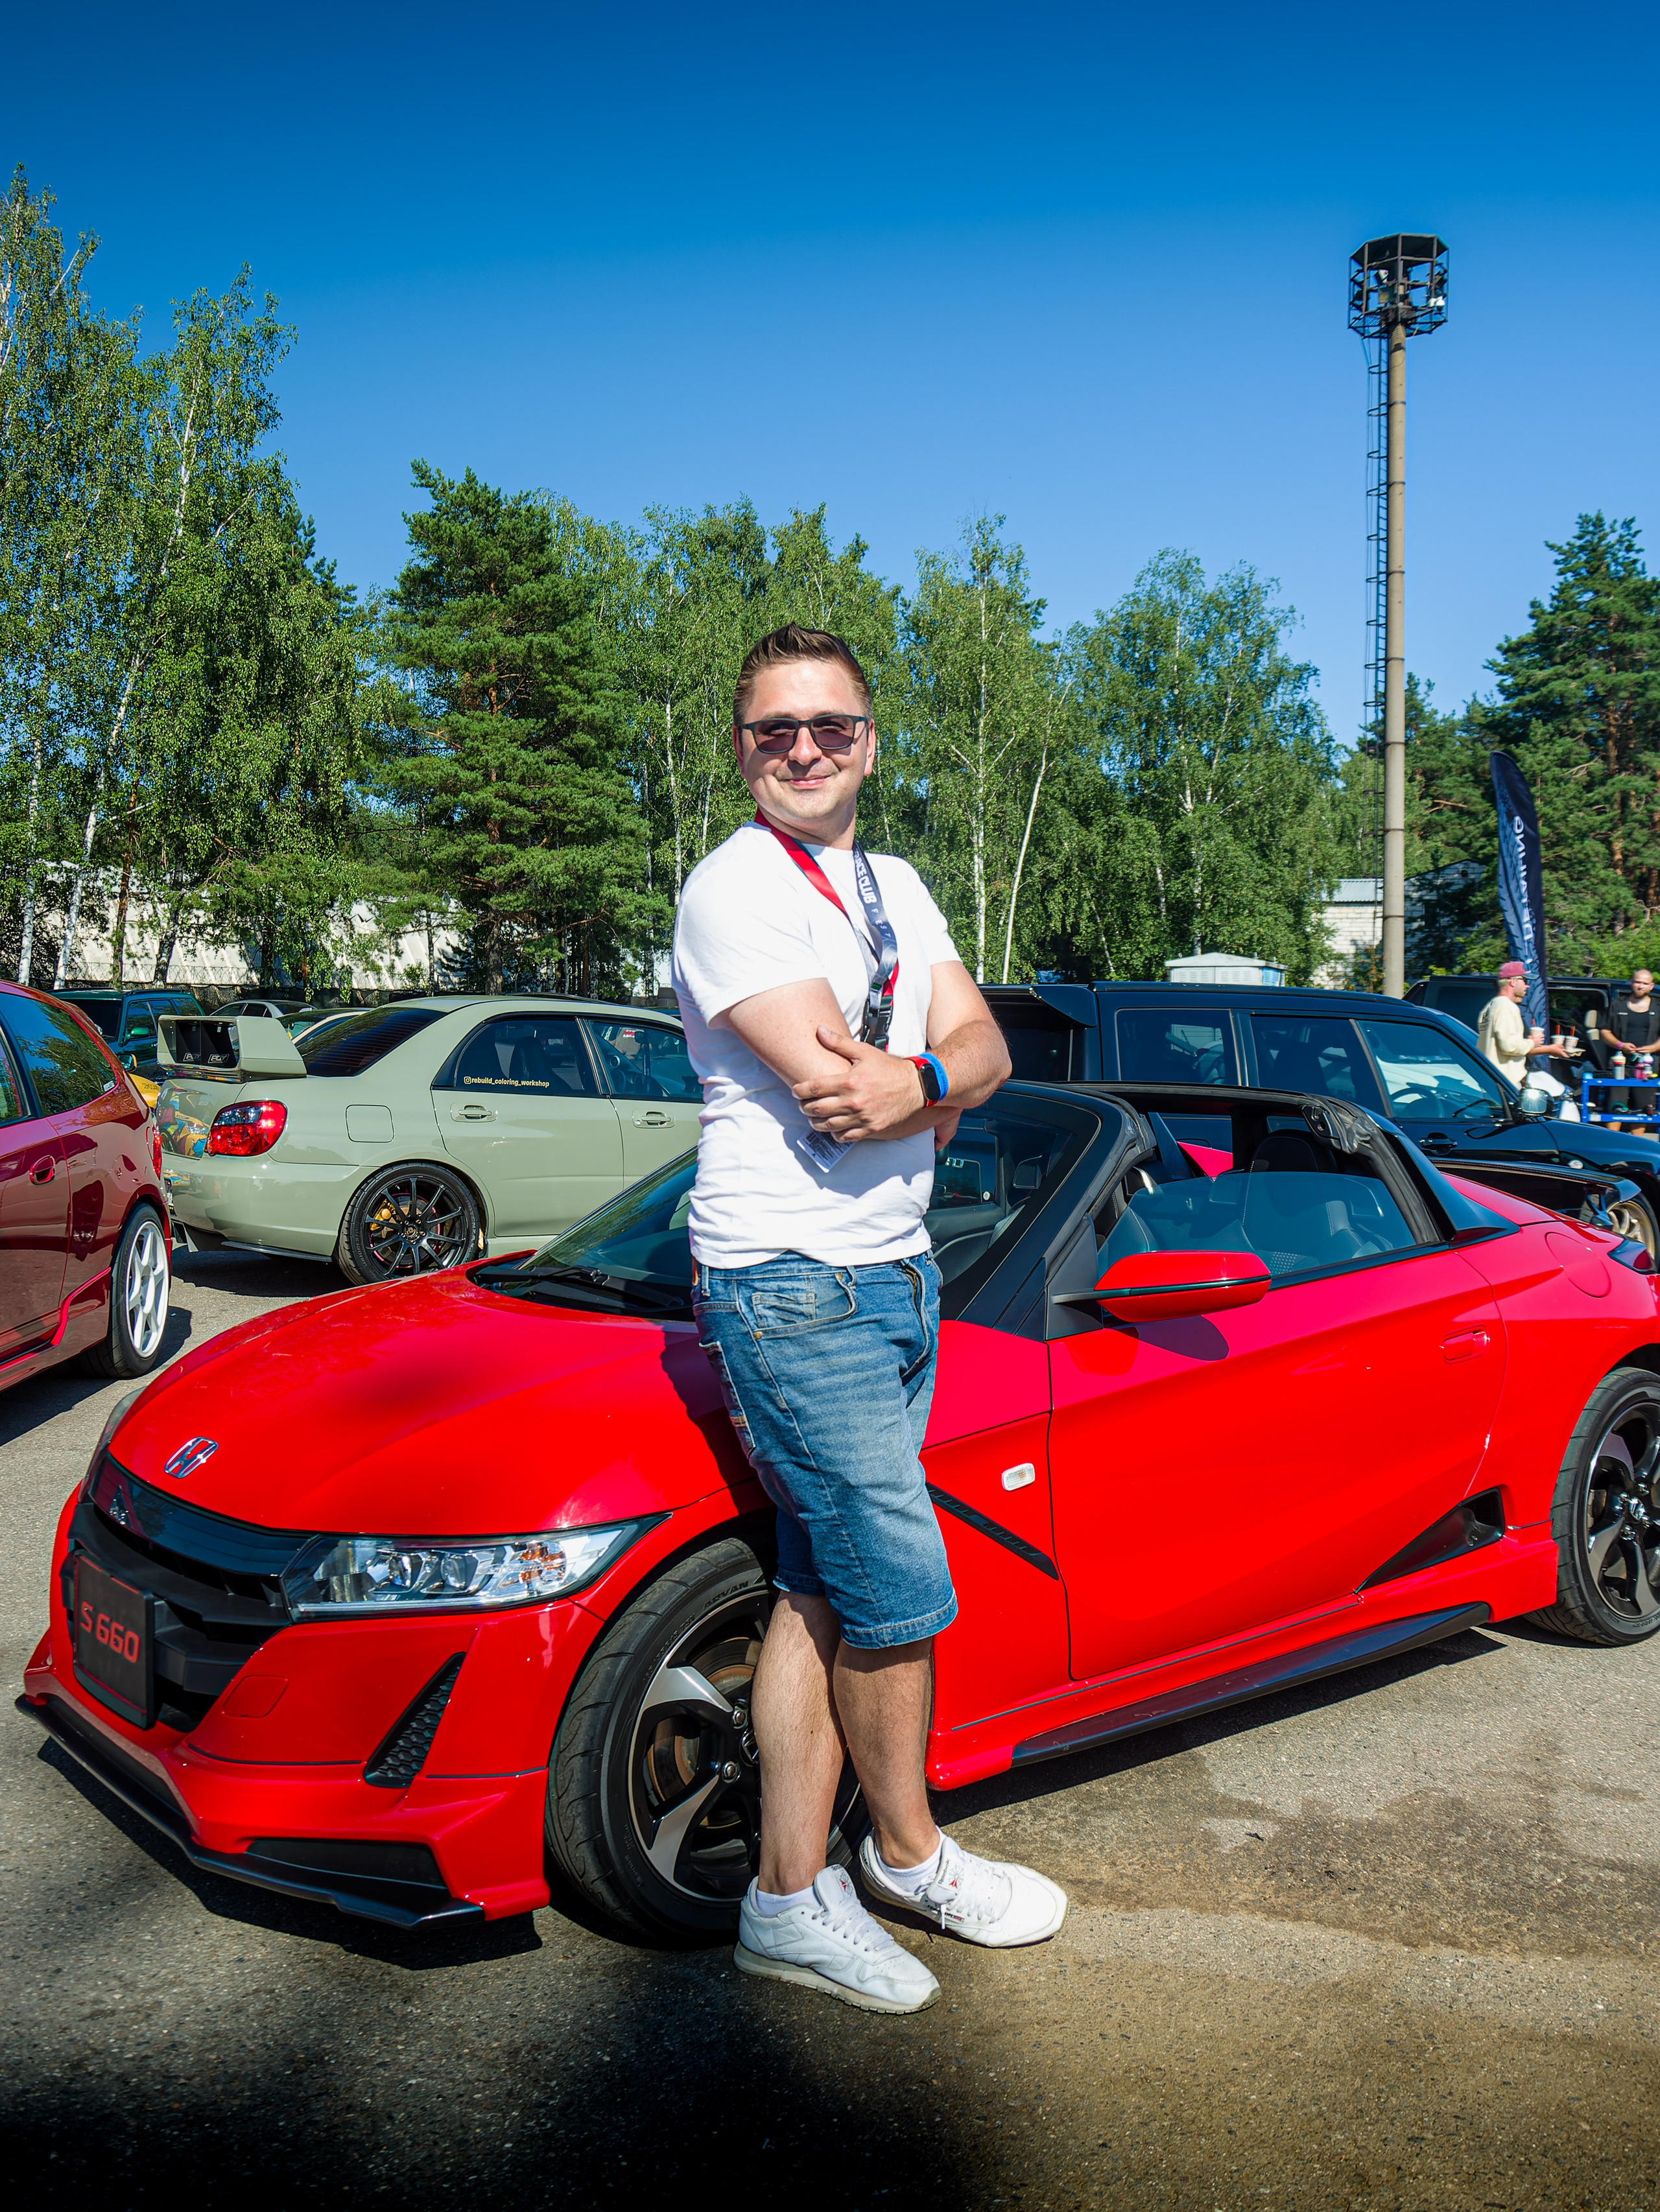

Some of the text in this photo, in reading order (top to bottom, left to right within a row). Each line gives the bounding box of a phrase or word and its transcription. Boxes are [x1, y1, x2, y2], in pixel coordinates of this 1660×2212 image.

[858, 875, 877, 904] CLUB
[871, 908, 891, 938] FEST
[471, 1077, 549, 1088] rebuild_coloring_workshop
[703, 1581, 748, 1611] ADVAN
[80, 1600, 141, 1664] S 660
[937, 1859, 950, 1885] Reebok
